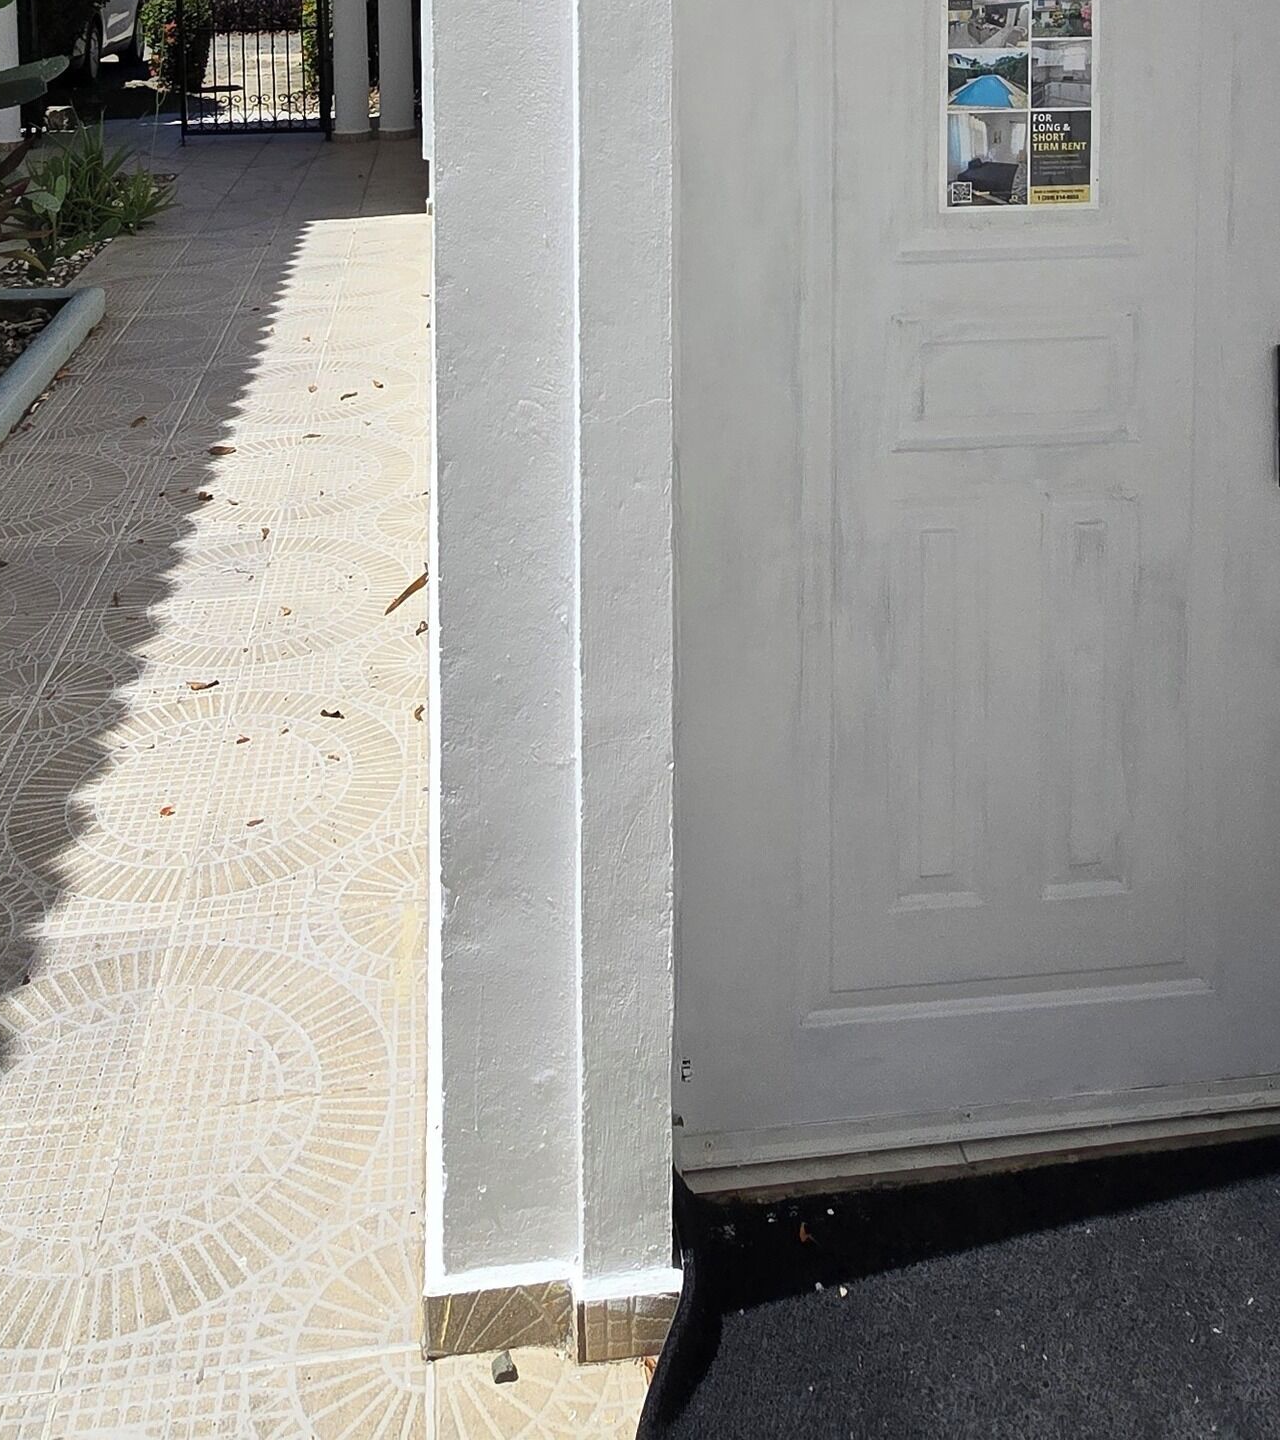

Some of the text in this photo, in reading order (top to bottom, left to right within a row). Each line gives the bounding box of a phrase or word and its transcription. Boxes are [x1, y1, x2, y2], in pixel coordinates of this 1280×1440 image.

[1032, 113, 1052, 122] FOR
[1032, 123, 1071, 132] LONG &
[1032, 133, 1065, 142] SHORT
[1032, 141, 1087, 151] TERM RENT
